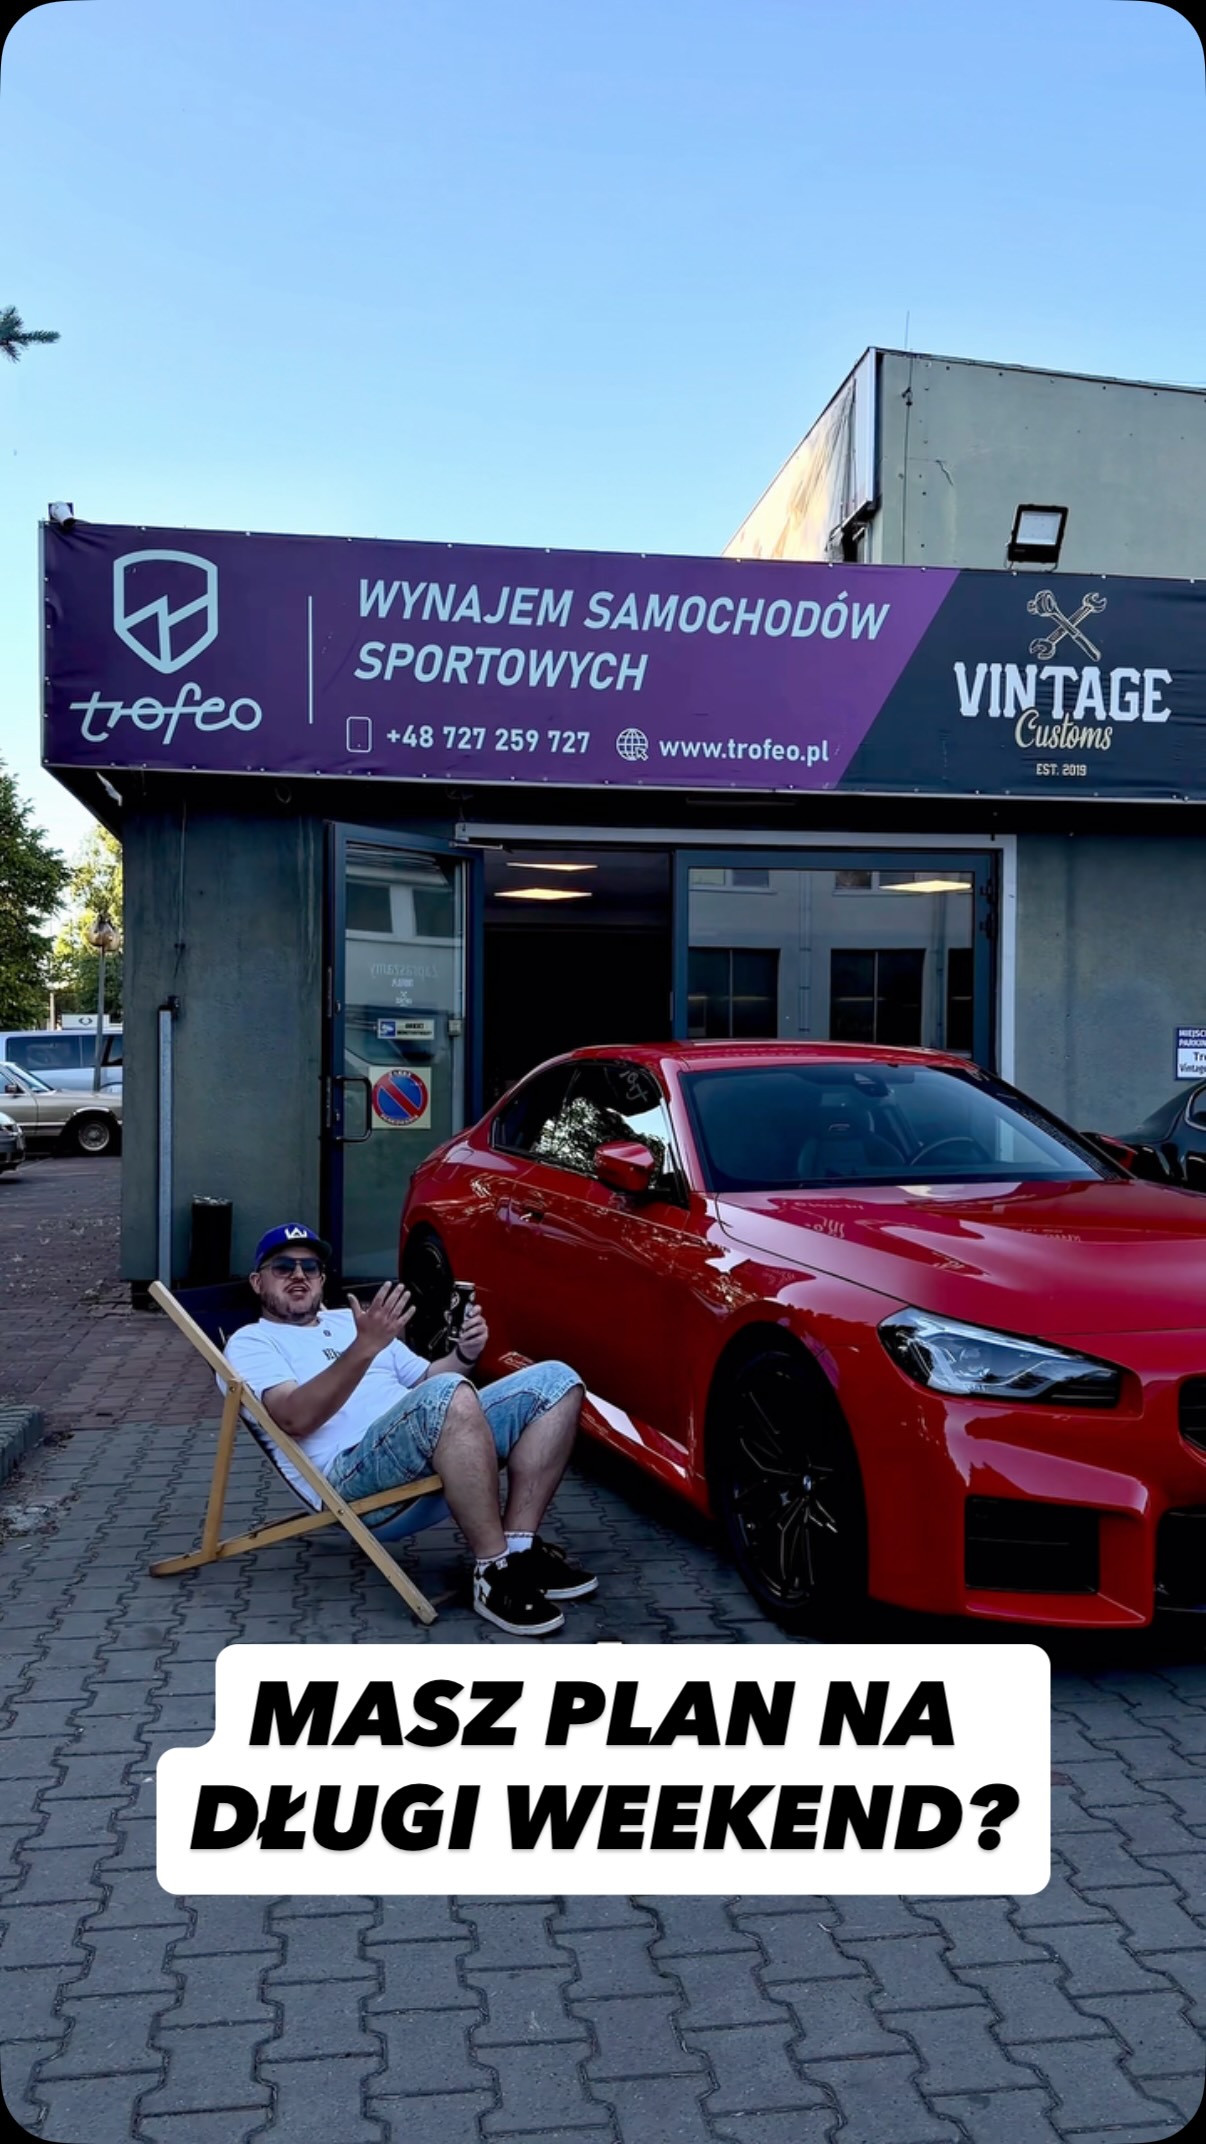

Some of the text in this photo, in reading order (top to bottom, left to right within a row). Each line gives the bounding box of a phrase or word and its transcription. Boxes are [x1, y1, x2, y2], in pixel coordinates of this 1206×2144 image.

[360, 579, 890, 640] WYNAJEM SAMOCHODÓW
[354, 642, 648, 691] SPORTOWYCH
[70, 682, 262, 745] trofeo
[954, 661, 1173, 722] VINTAGE
[387, 724, 590, 753] +48 727 259 727
[1015, 709, 1113, 750] Customs
[659, 738, 829, 767] www.trofeo.pl
[1036, 763, 1087, 777] EST. 2019
